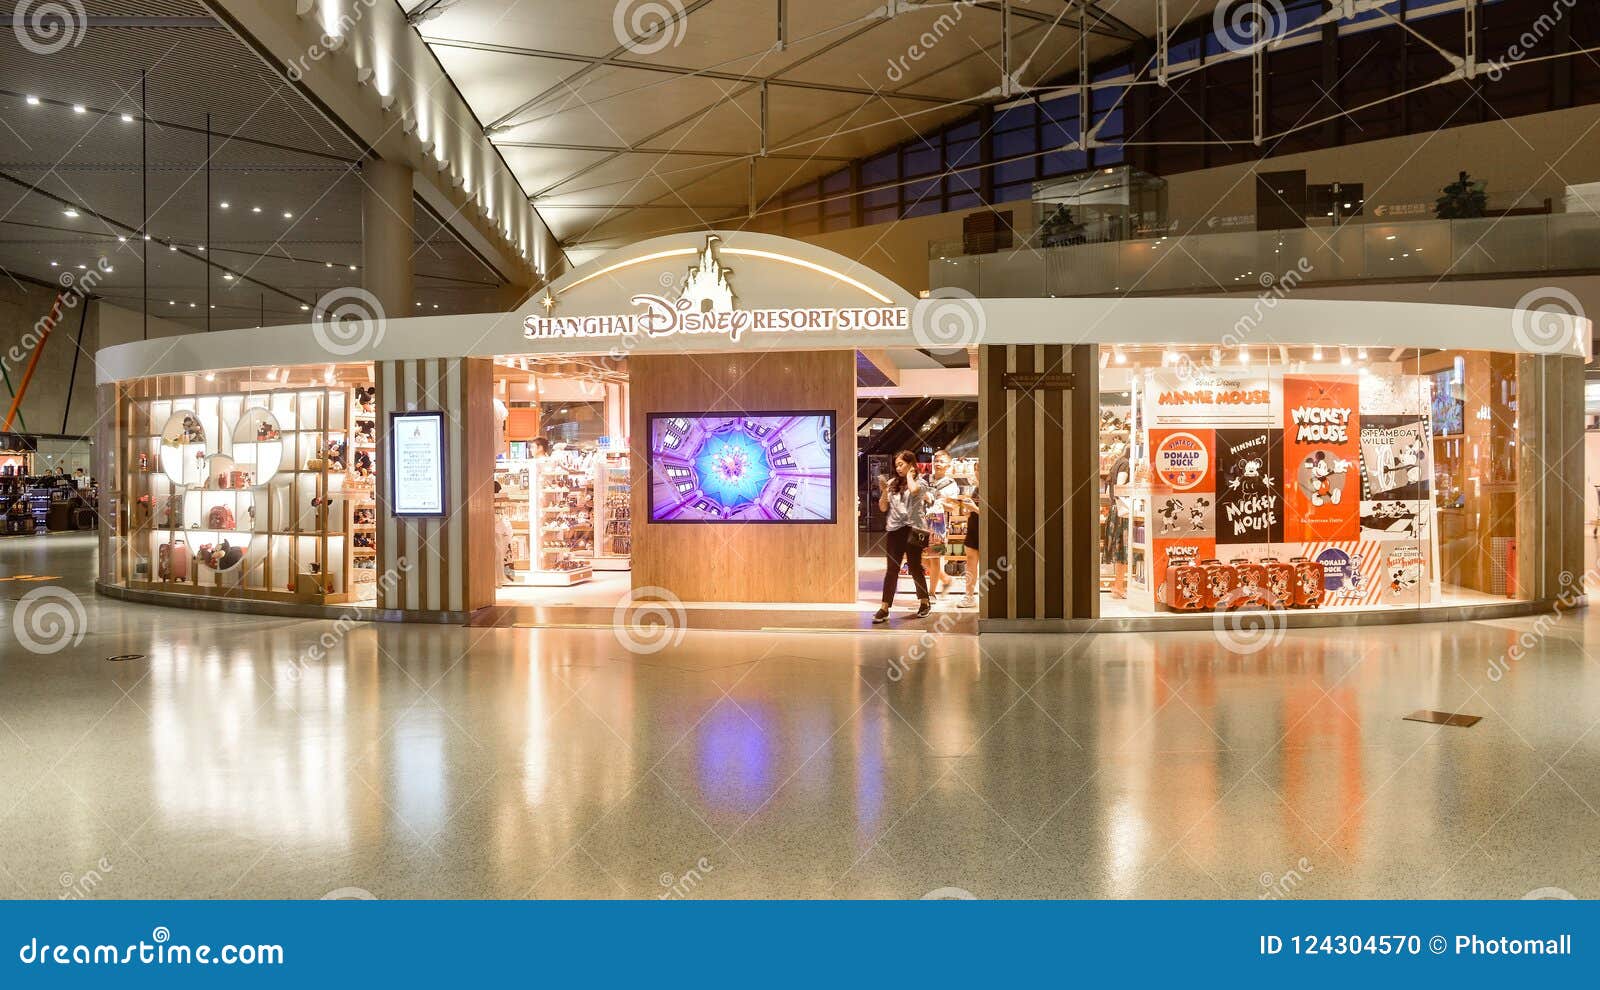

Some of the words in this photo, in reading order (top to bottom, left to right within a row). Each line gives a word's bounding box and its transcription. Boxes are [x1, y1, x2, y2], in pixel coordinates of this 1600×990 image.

[523, 315, 634, 337] SHANGHAI
[753, 310, 833, 329] RESORT
[838, 309, 907, 328] STORE
[1158, 390, 1214, 405] MINNIE
[1216, 390, 1271, 404] MOUSE
[1291, 406, 1351, 424] MICKEY
[1296, 425, 1348, 444] MOUSE
[1361, 429, 1418, 438] STEAMBOAT
[1230, 435, 1267, 455] MINNIE?
[1226, 495, 1277, 522] MICKEY
[1234, 511, 1277, 536] MOUSE
[1165, 546, 1198, 556] MICKEY
